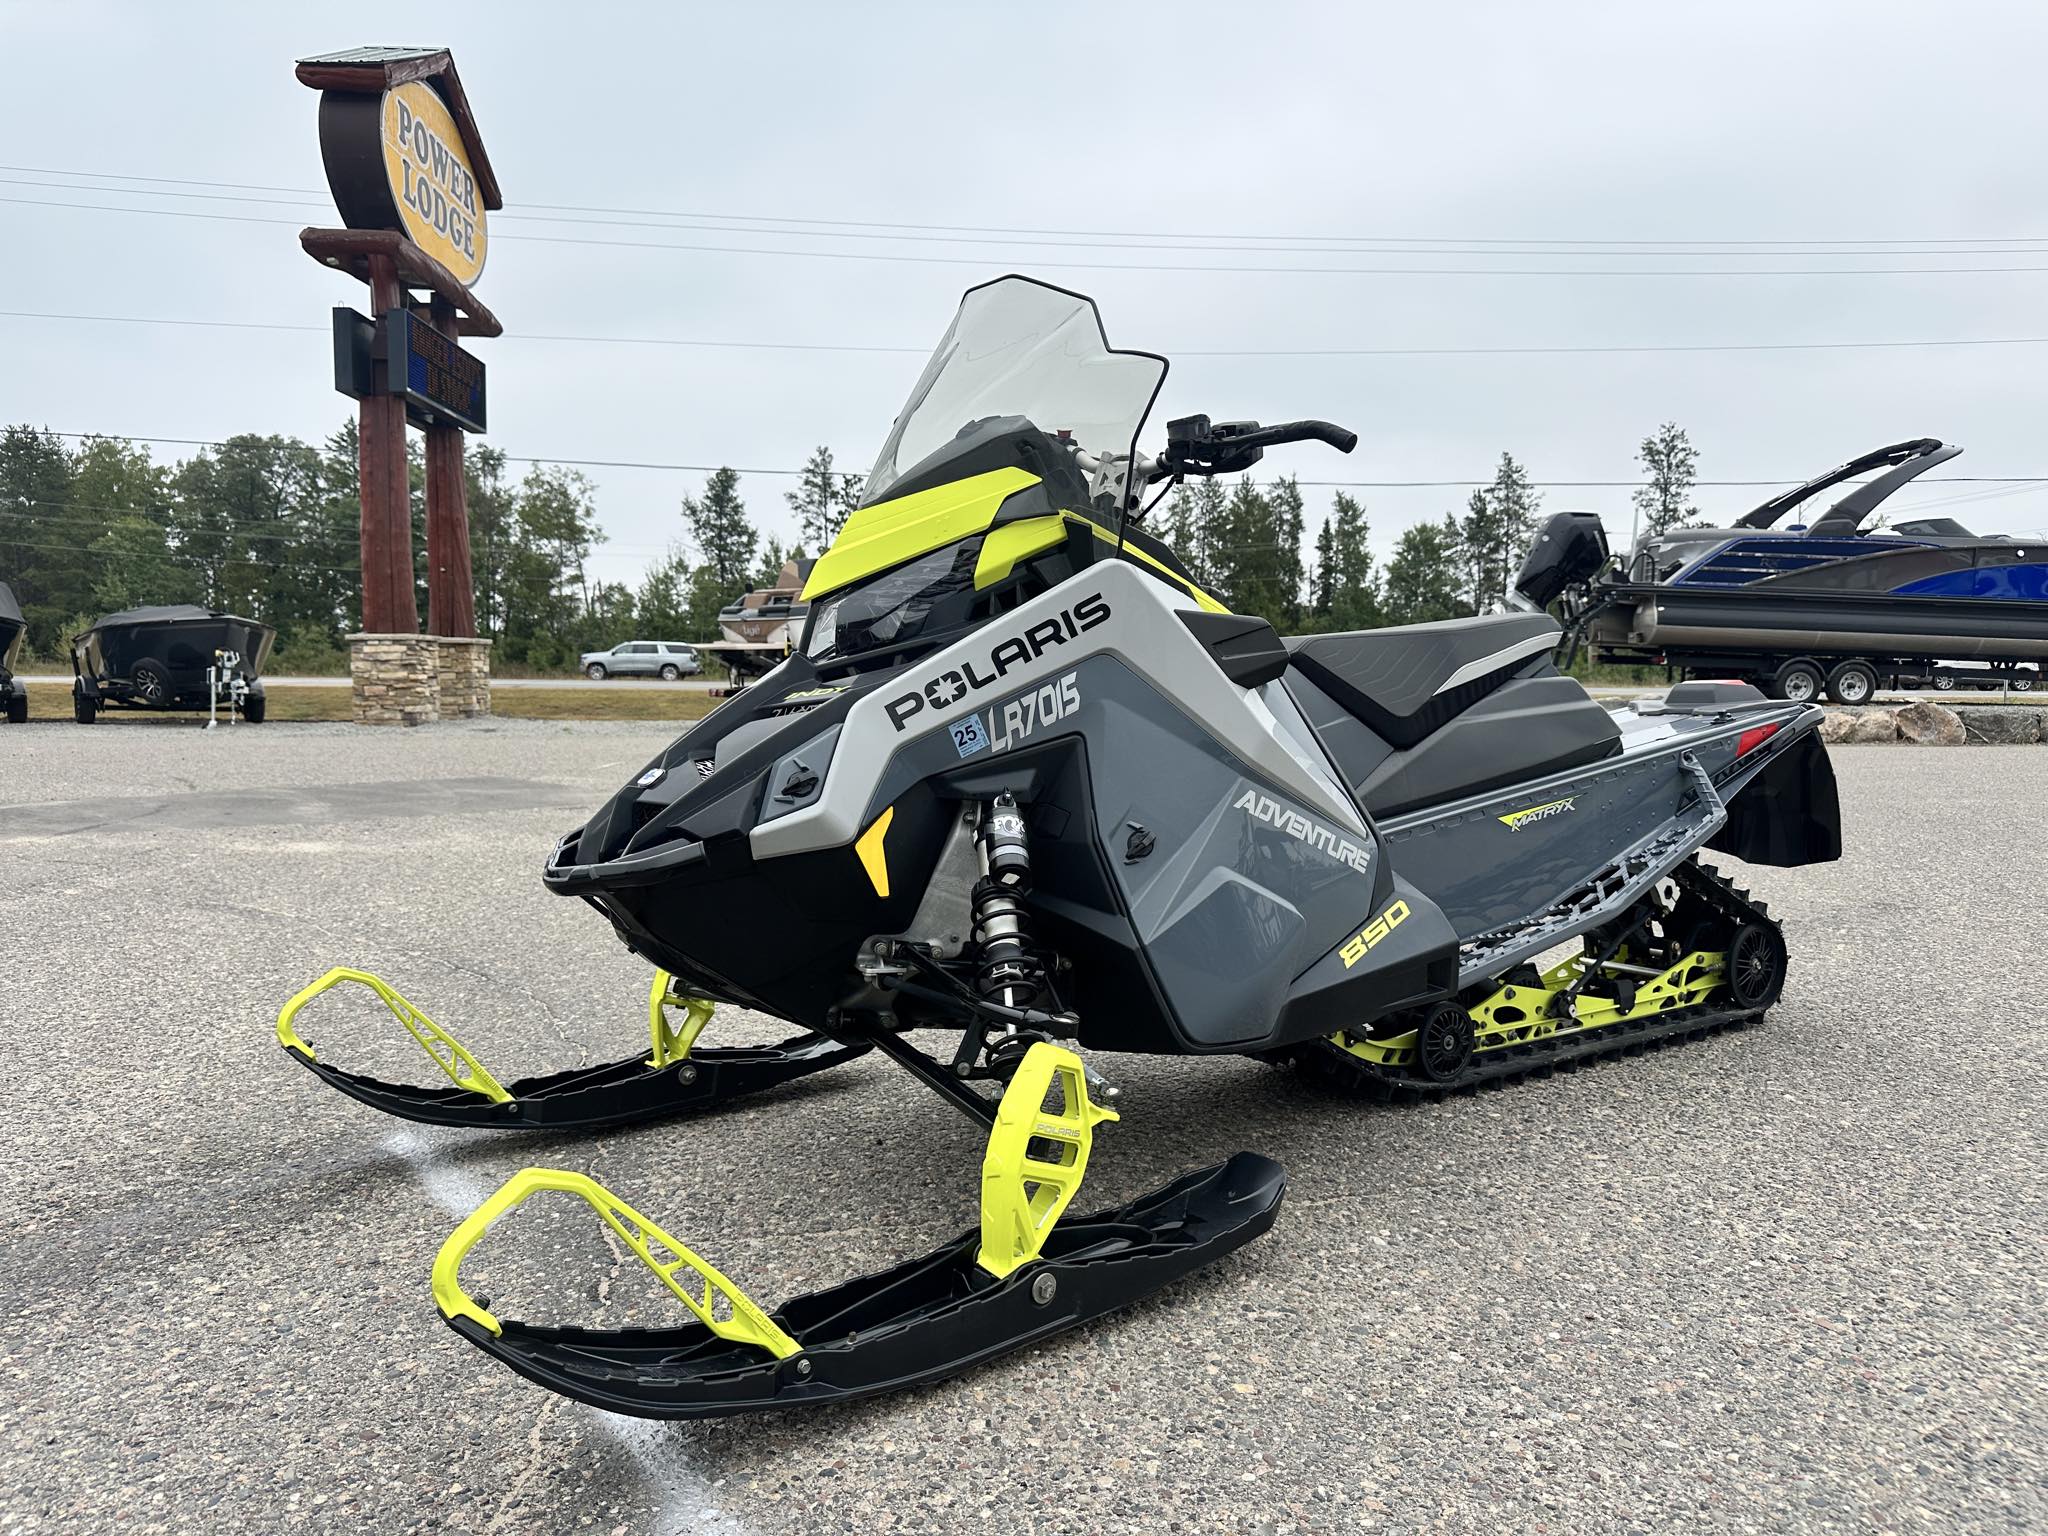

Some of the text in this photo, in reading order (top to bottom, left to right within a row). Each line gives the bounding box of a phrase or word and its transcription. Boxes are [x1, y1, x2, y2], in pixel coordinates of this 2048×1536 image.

[398, 99, 477, 217] POWER
[403, 159, 475, 260] LODGE
[884, 592, 1112, 733] POLARIS
[783, 685, 851, 700] INDY
[988, 671, 1081, 753] LR7015
[954, 724, 977, 747] 25
[993, 815, 1026, 838] FOX
[1233, 790, 1371, 874] ADVENTURE
[1511, 798, 1576, 832] MATRYX
[1338, 899, 1411, 970] 850
[1036, 1123, 1081, 1138] POLARIS
[734, 1293, 781, 1340] POLARIS
